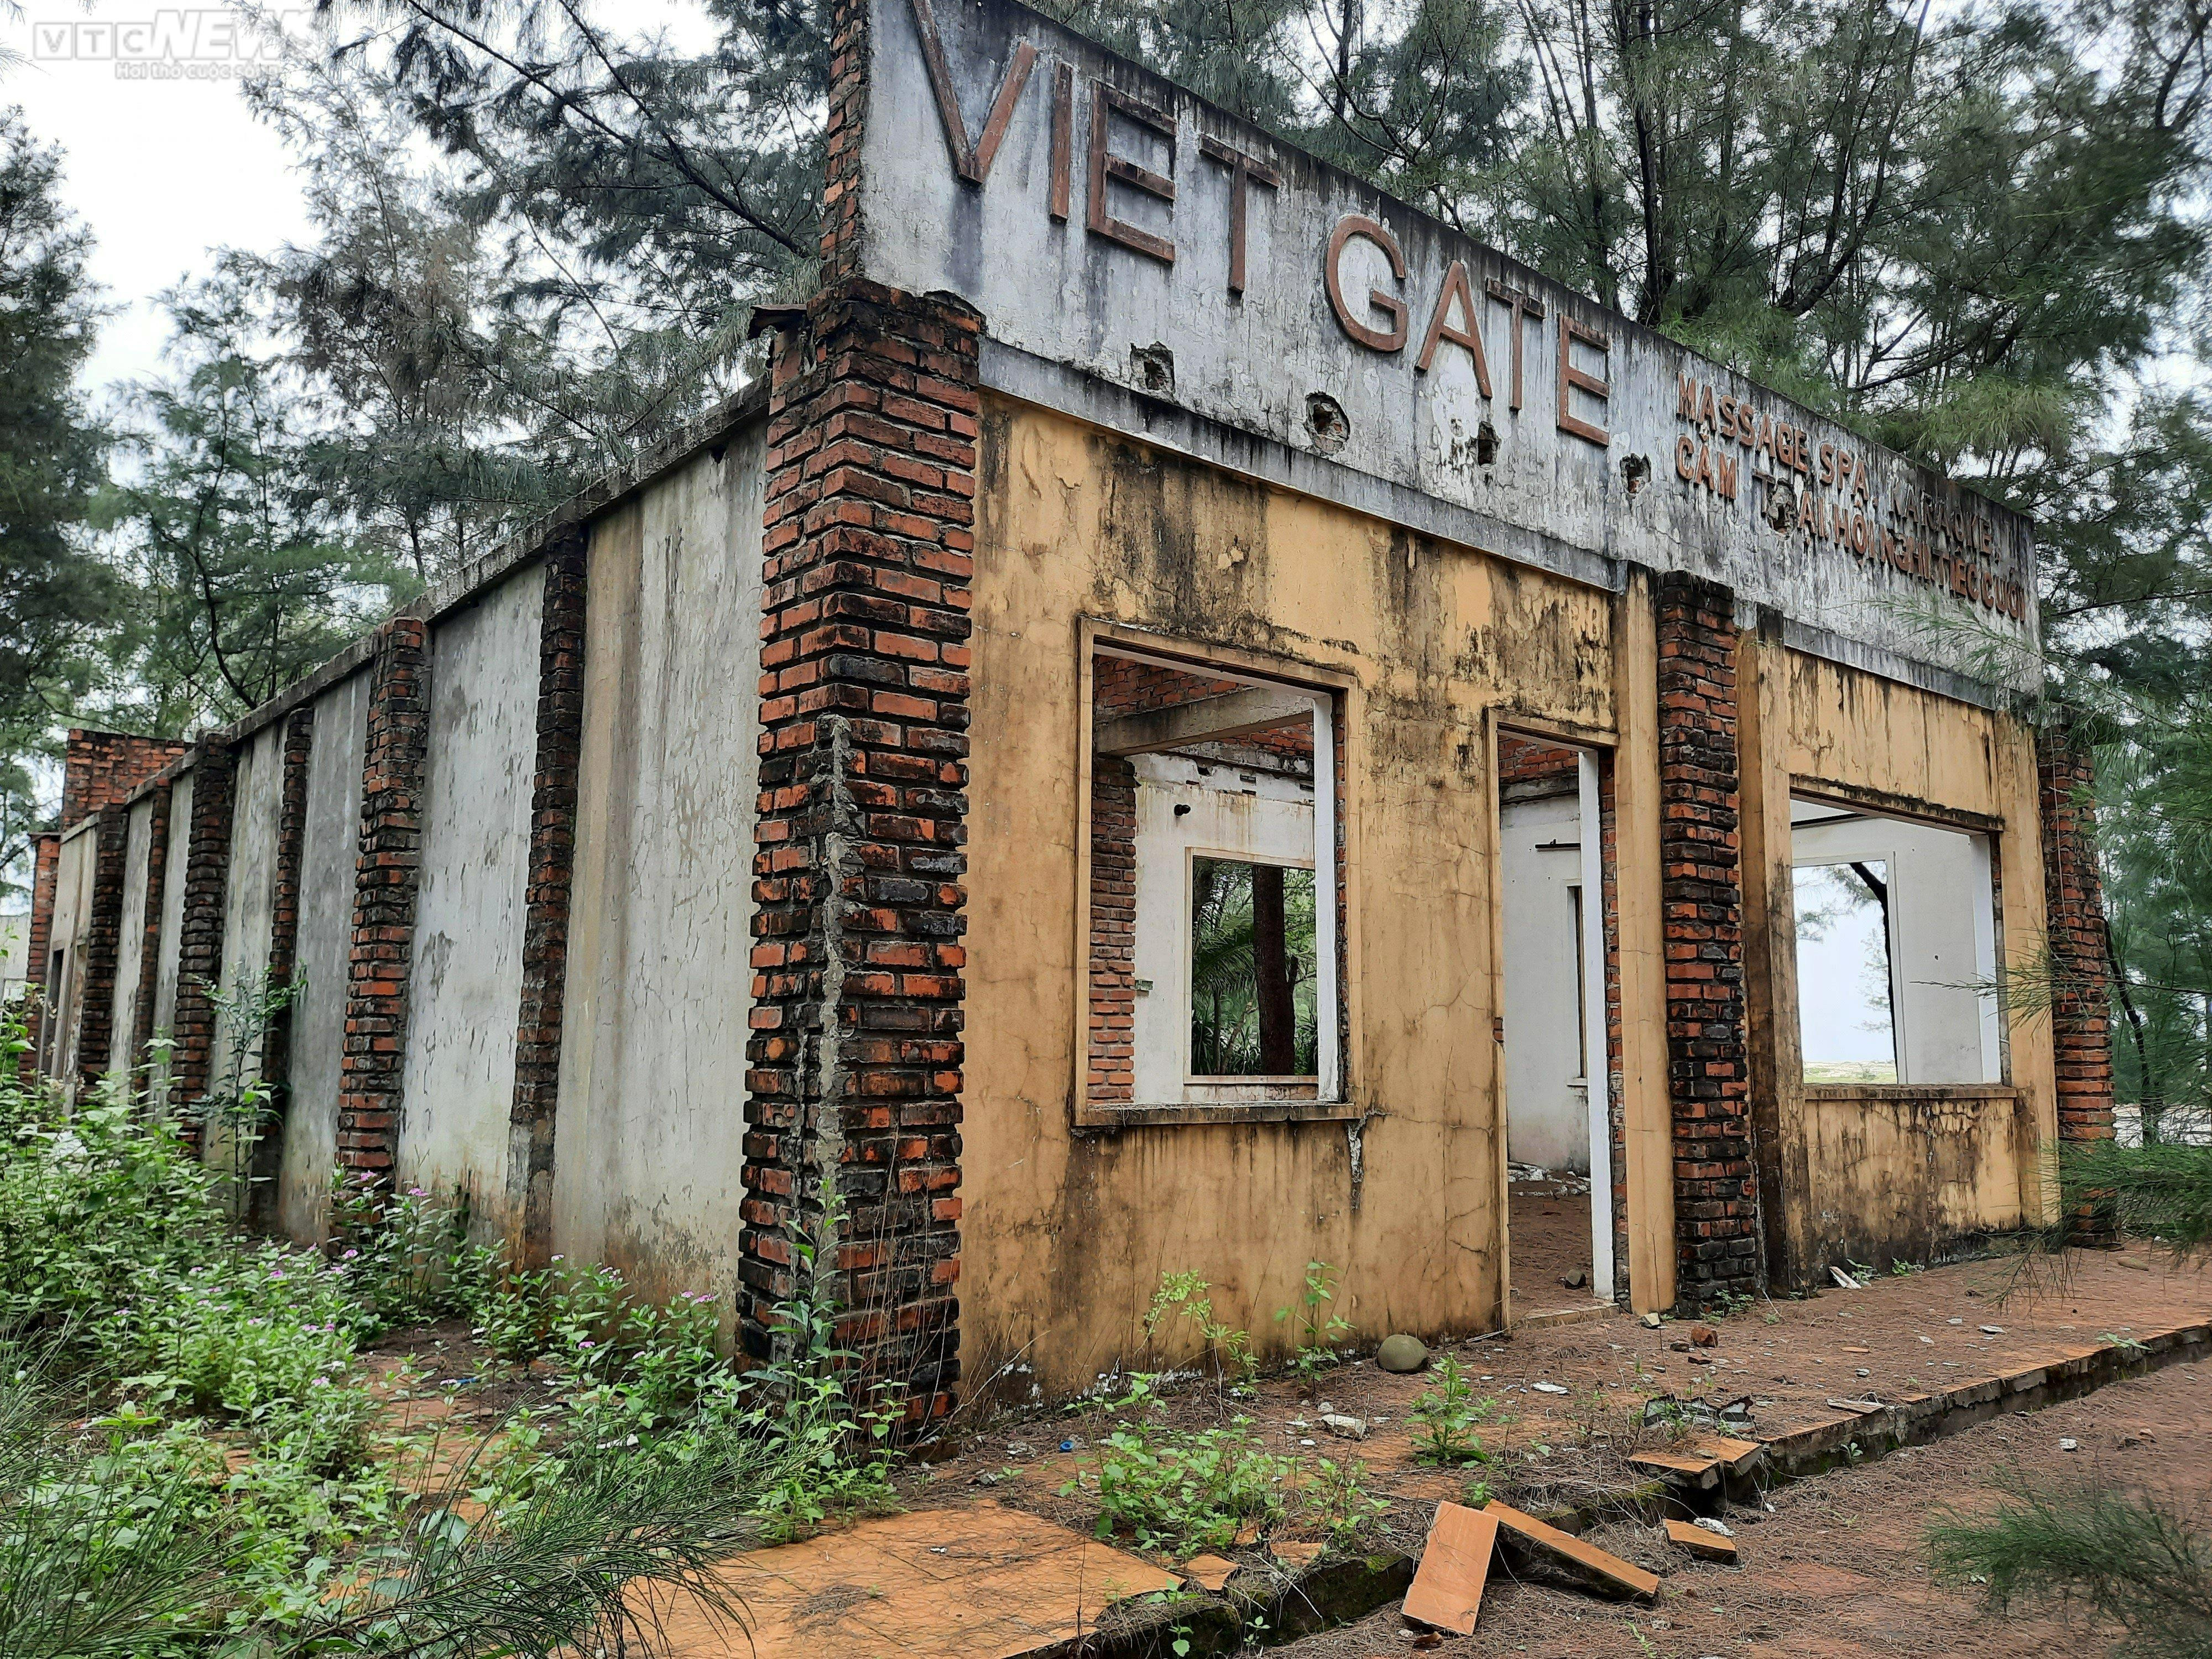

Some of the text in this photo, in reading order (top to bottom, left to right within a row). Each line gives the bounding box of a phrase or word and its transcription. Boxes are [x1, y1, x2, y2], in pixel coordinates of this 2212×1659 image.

[912, 0, 1609, 446] VIET GATE
[1677, 373, 1809, 472] MASSAGE
